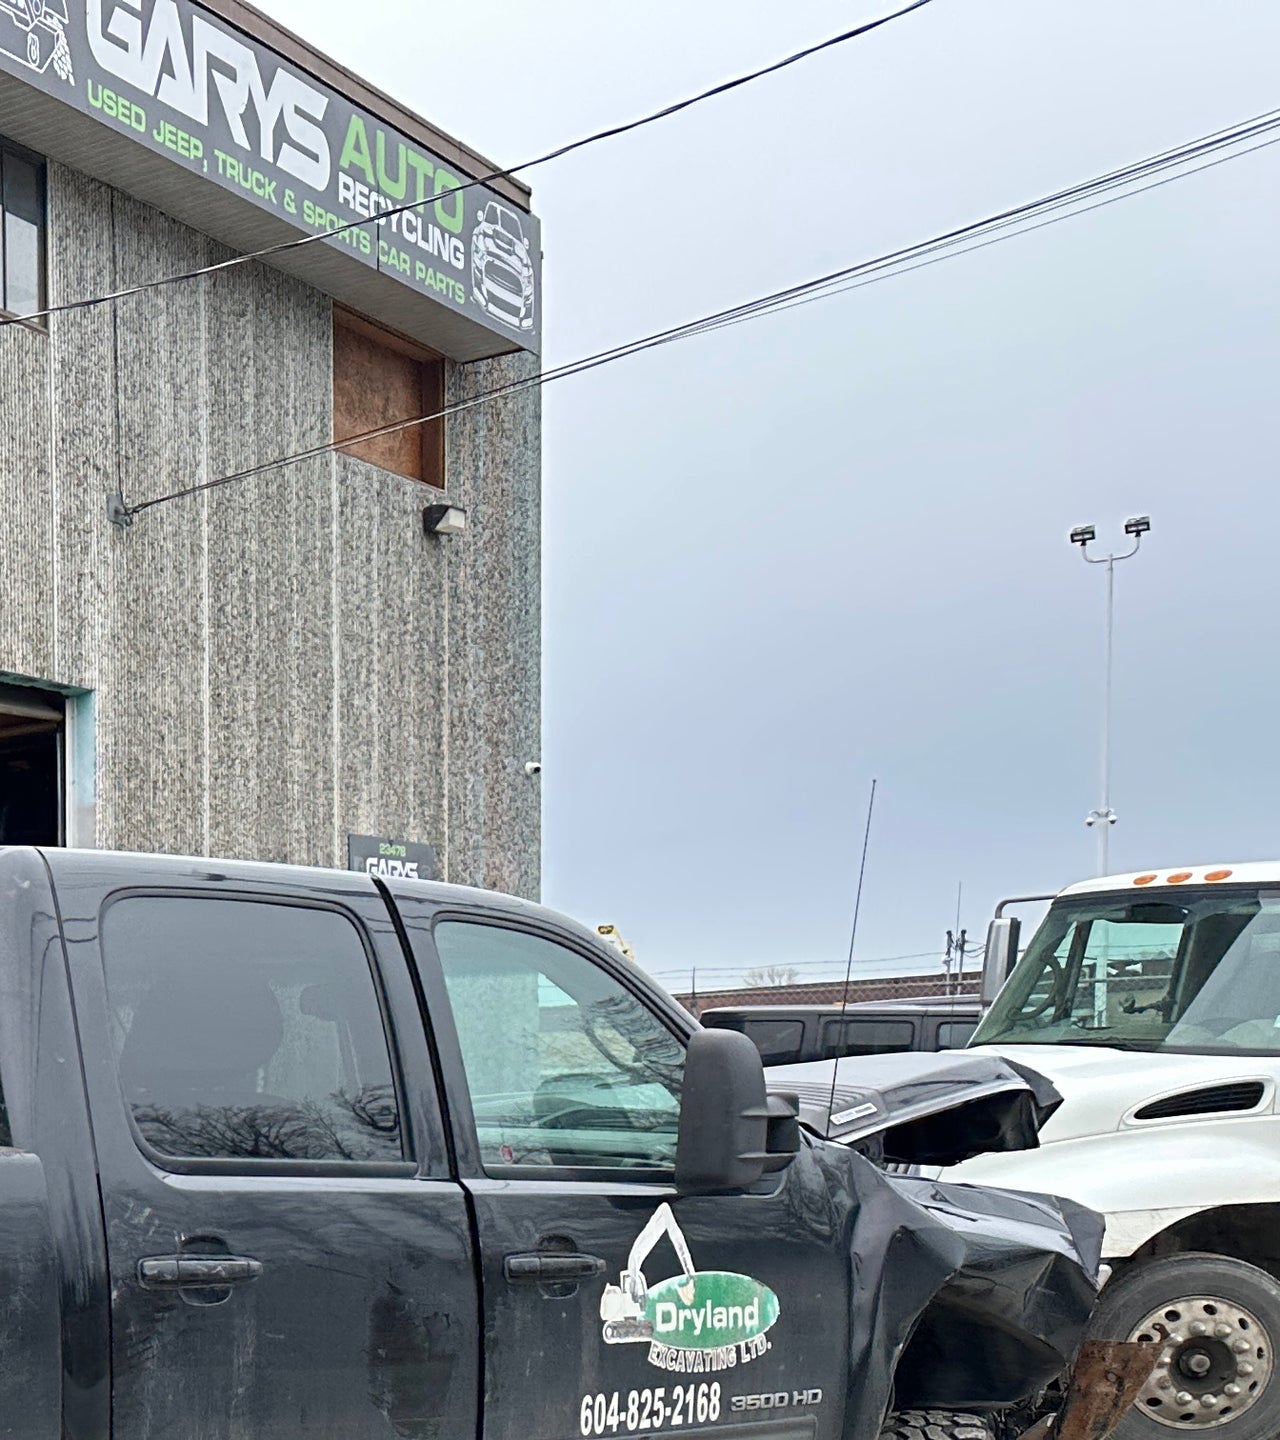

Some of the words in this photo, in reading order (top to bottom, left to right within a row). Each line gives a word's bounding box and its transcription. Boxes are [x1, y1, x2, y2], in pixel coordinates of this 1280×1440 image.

[86, 0, 331, 192] GARYS
[87, 79, 146, 133] USED
[152, 120, 208, 173] JEEP,
[214, 149, 278, 204] TRUCK
[283, 188, 297, 214] &
[303, 200, 371, 254] SPORTS
[378, 240, 410, 276] CAR
[415, 260, 465, 304] PARTS
[340, 113, 464, 234] AUTO
[339, 171, 465, 270] RECYCLING
[647, 1342, 737, 1373] EXCAVATING
[740, 1331, 772, 1364] LTD.
[655, 1297, 759, 1335] Dryland
[580, 1381, 721, 1436] 604-825-2168
[731, 1394, 790, 1412] 3500
[793, 1388, 823, 1406] HD
